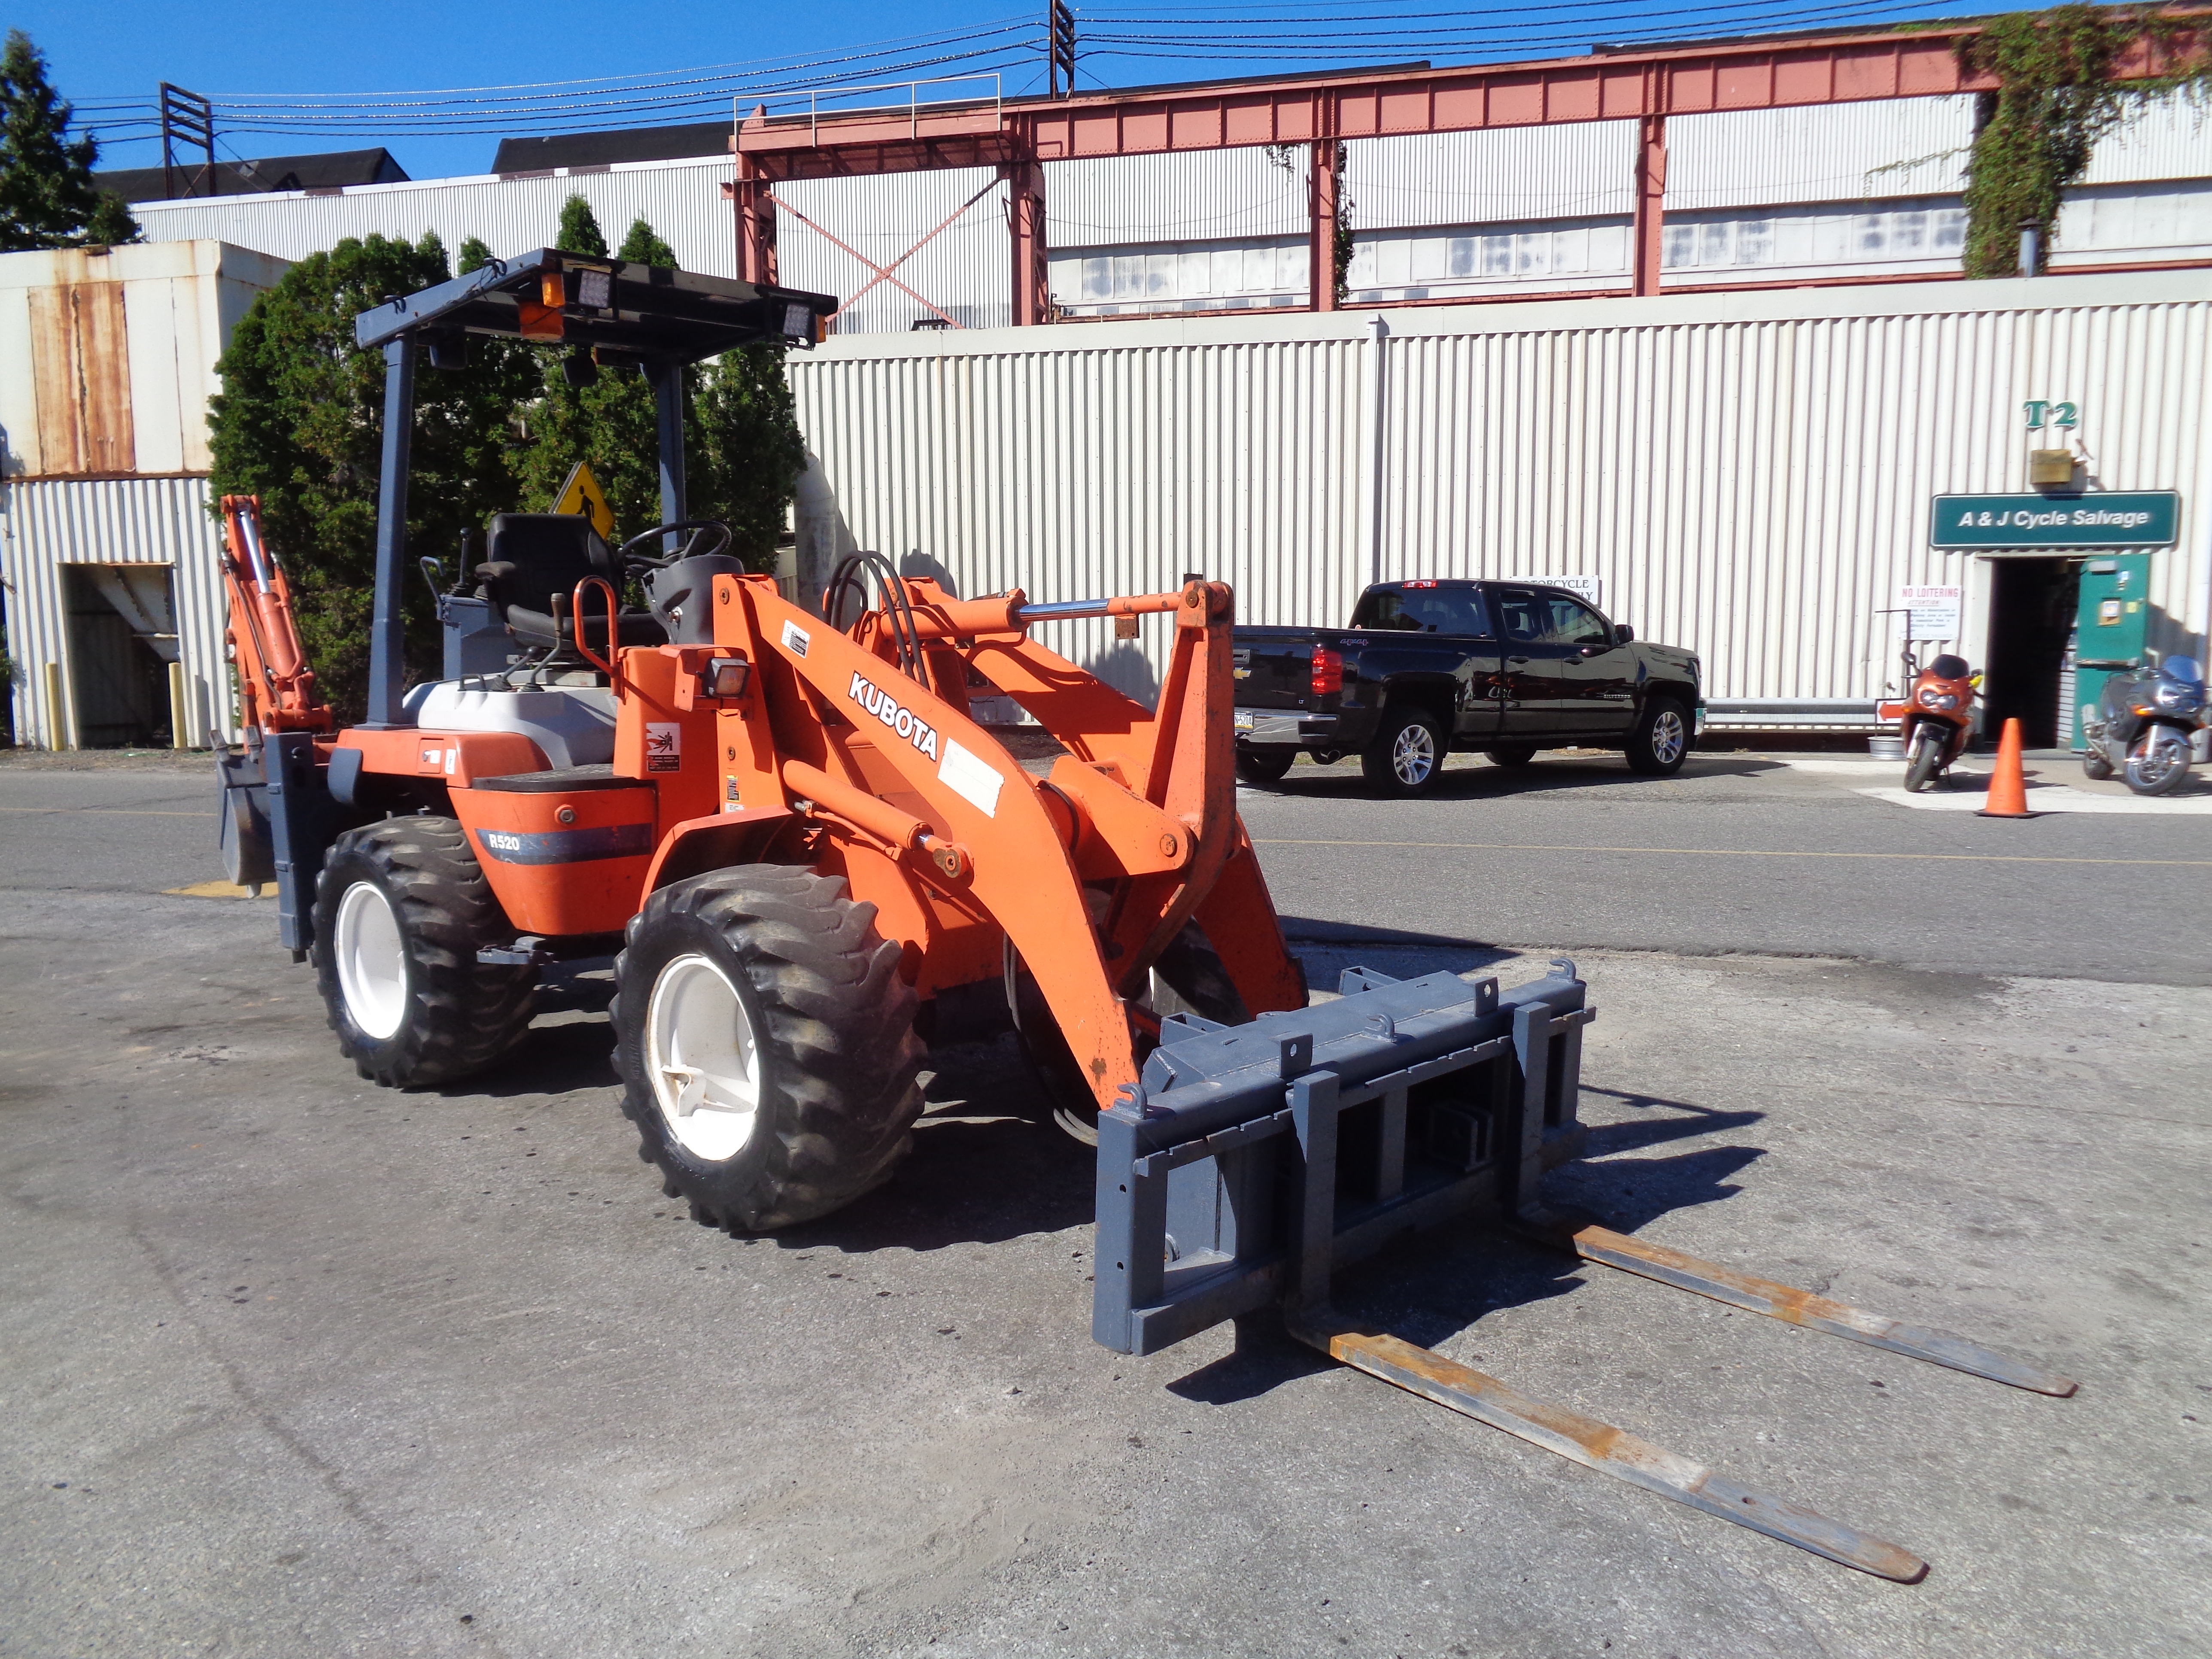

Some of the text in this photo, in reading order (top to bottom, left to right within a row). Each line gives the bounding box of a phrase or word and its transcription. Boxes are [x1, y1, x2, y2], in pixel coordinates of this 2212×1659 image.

[2023, 400, 2078, 428] T2
[1958, 510, 2149, 529] A & J Cycle Salvage
[1902, 588, 1958, 597] NO LOITERING
[848, 670, 937, 763] KUBOTA
[489, 834, 520, 851] R520
